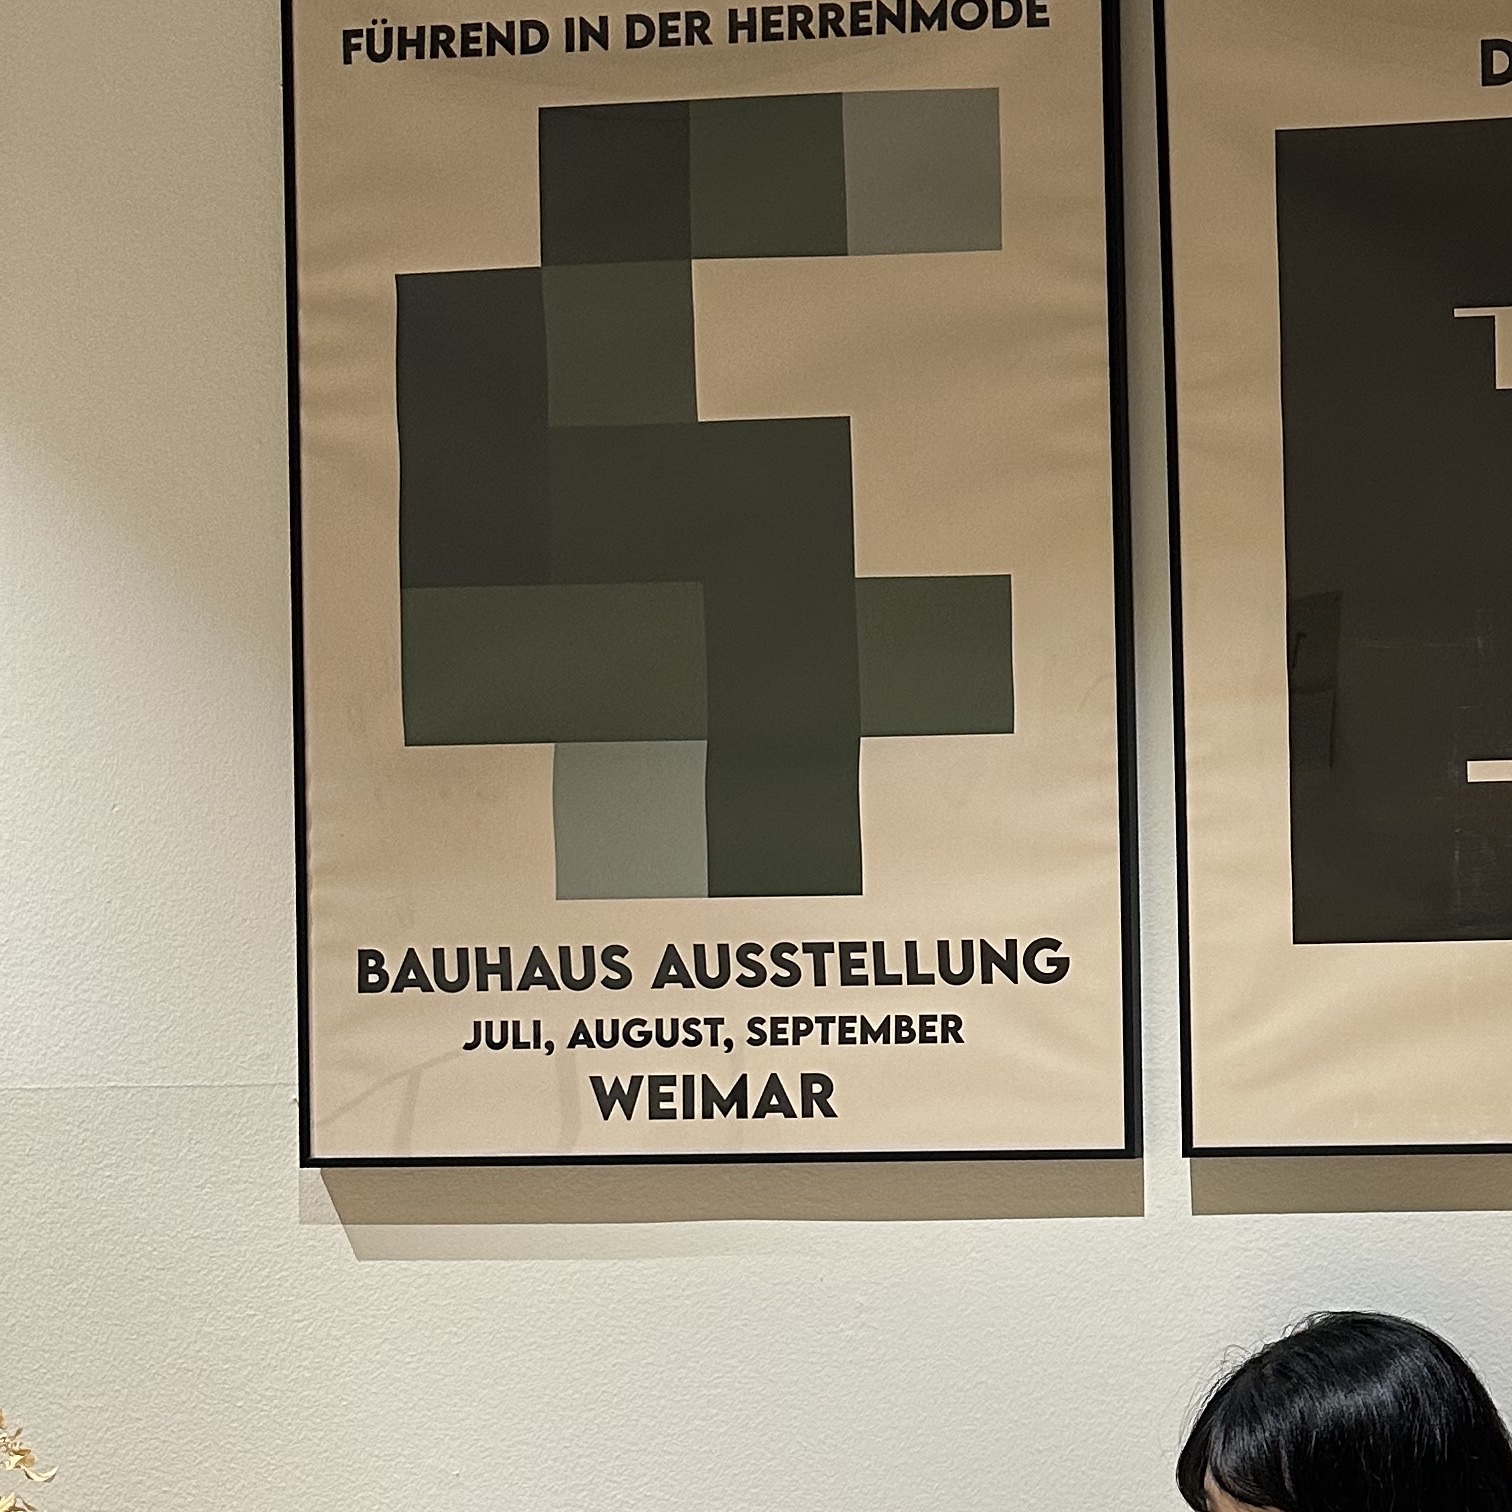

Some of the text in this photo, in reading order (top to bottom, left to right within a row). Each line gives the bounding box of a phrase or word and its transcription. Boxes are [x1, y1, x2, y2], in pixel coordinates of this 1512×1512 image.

[341, 0, 1050, 65] FÜHREND IN DER HERRENMODE
[357, 937, 1071, 994] BAUHAUS AUSSTELLUNG
[463, 1014, 964, 1055] JULI, AUGUST, SEPTEMBER
[589, 1072, 838, 1121] WEIMAR
